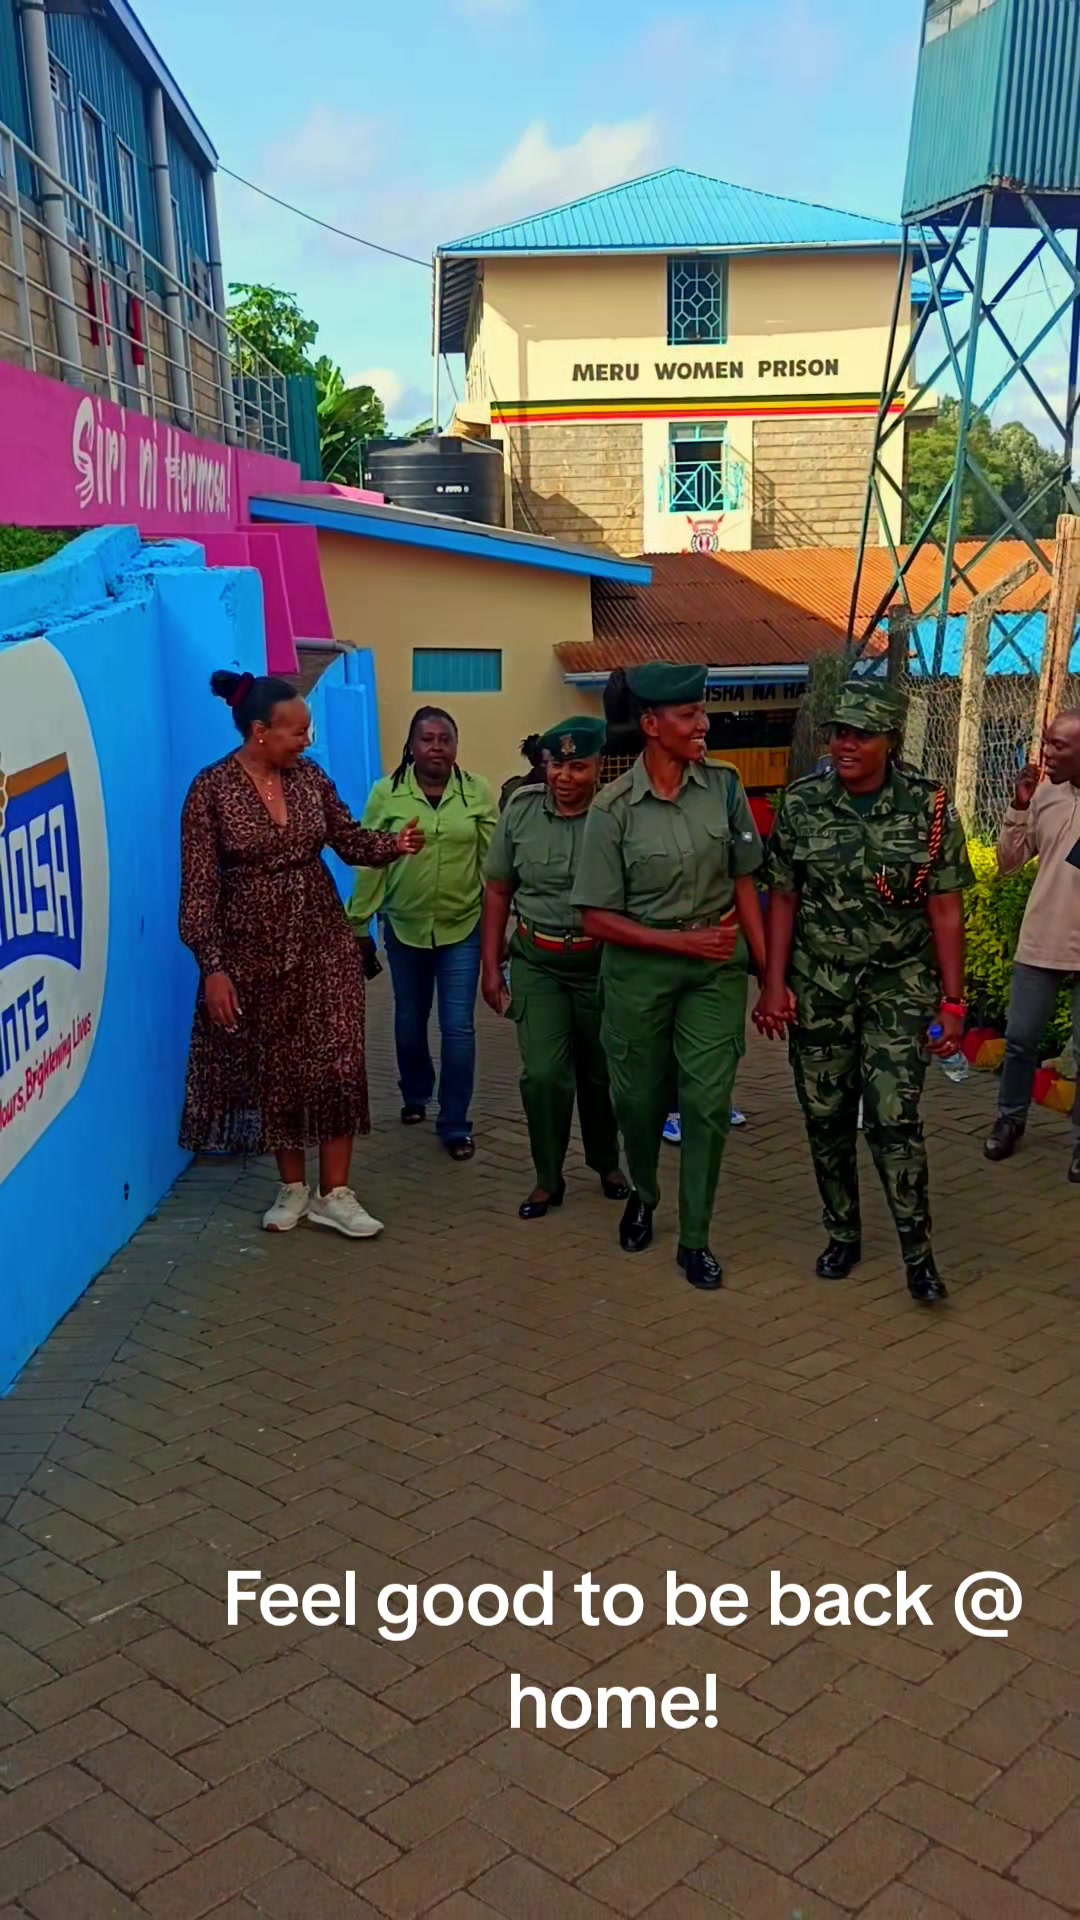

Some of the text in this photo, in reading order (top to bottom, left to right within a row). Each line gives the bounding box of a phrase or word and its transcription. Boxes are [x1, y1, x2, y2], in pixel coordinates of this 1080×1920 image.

[572, 359, 838, 381] MERU WOMEN PRISON
[73, 397, 126, 509] Siri
[140, 419, 158, 510] ni
[752, 683, 776, 700] NA
[73, 1012, 91, 1050] Lives
